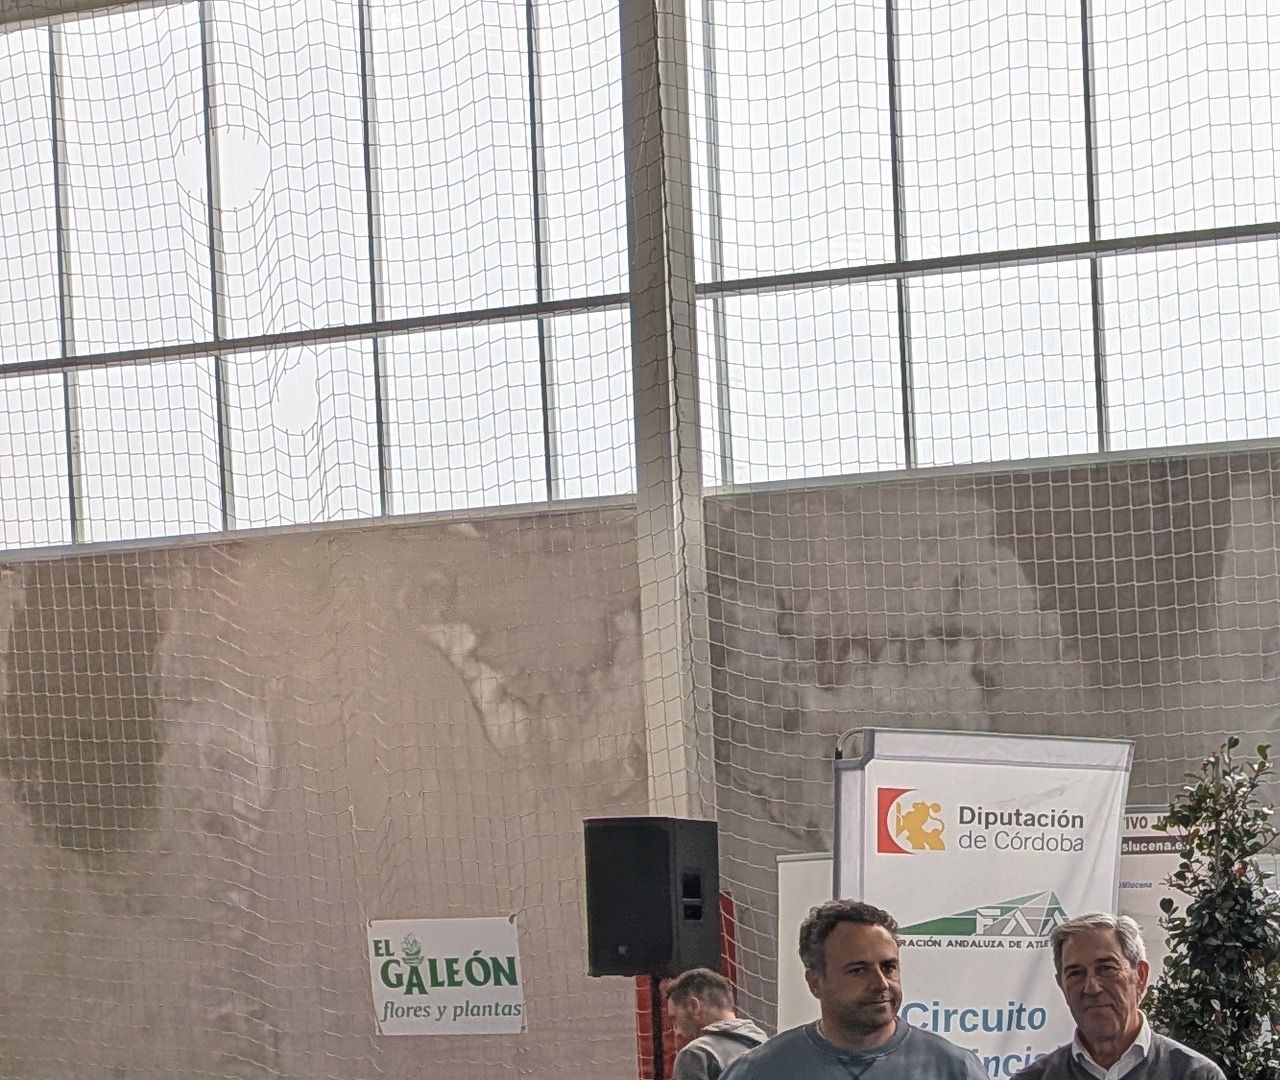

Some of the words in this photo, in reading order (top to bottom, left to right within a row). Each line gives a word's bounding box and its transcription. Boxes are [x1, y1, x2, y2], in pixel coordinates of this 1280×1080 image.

[959, 806, 1084, 829] Diputación
[959, 832, 986, 849] de
[995, 831, 1084, 851] Córdoba
[373, 940, 395, 957] EL
[897, 936, 942, 949] RACIÓN
[946, 939, 1004, 949] ANDALUZA
[1008, 940, 1023, 949] DE
[381, 950, 519, 995] GALEÓN
[380, 1001, 431, 1022] flores
[435, 1005, 447, 1021] y
[453, 1000, 522, 1021] plantas
[901, 1001, 1047, 1032] Circuito
